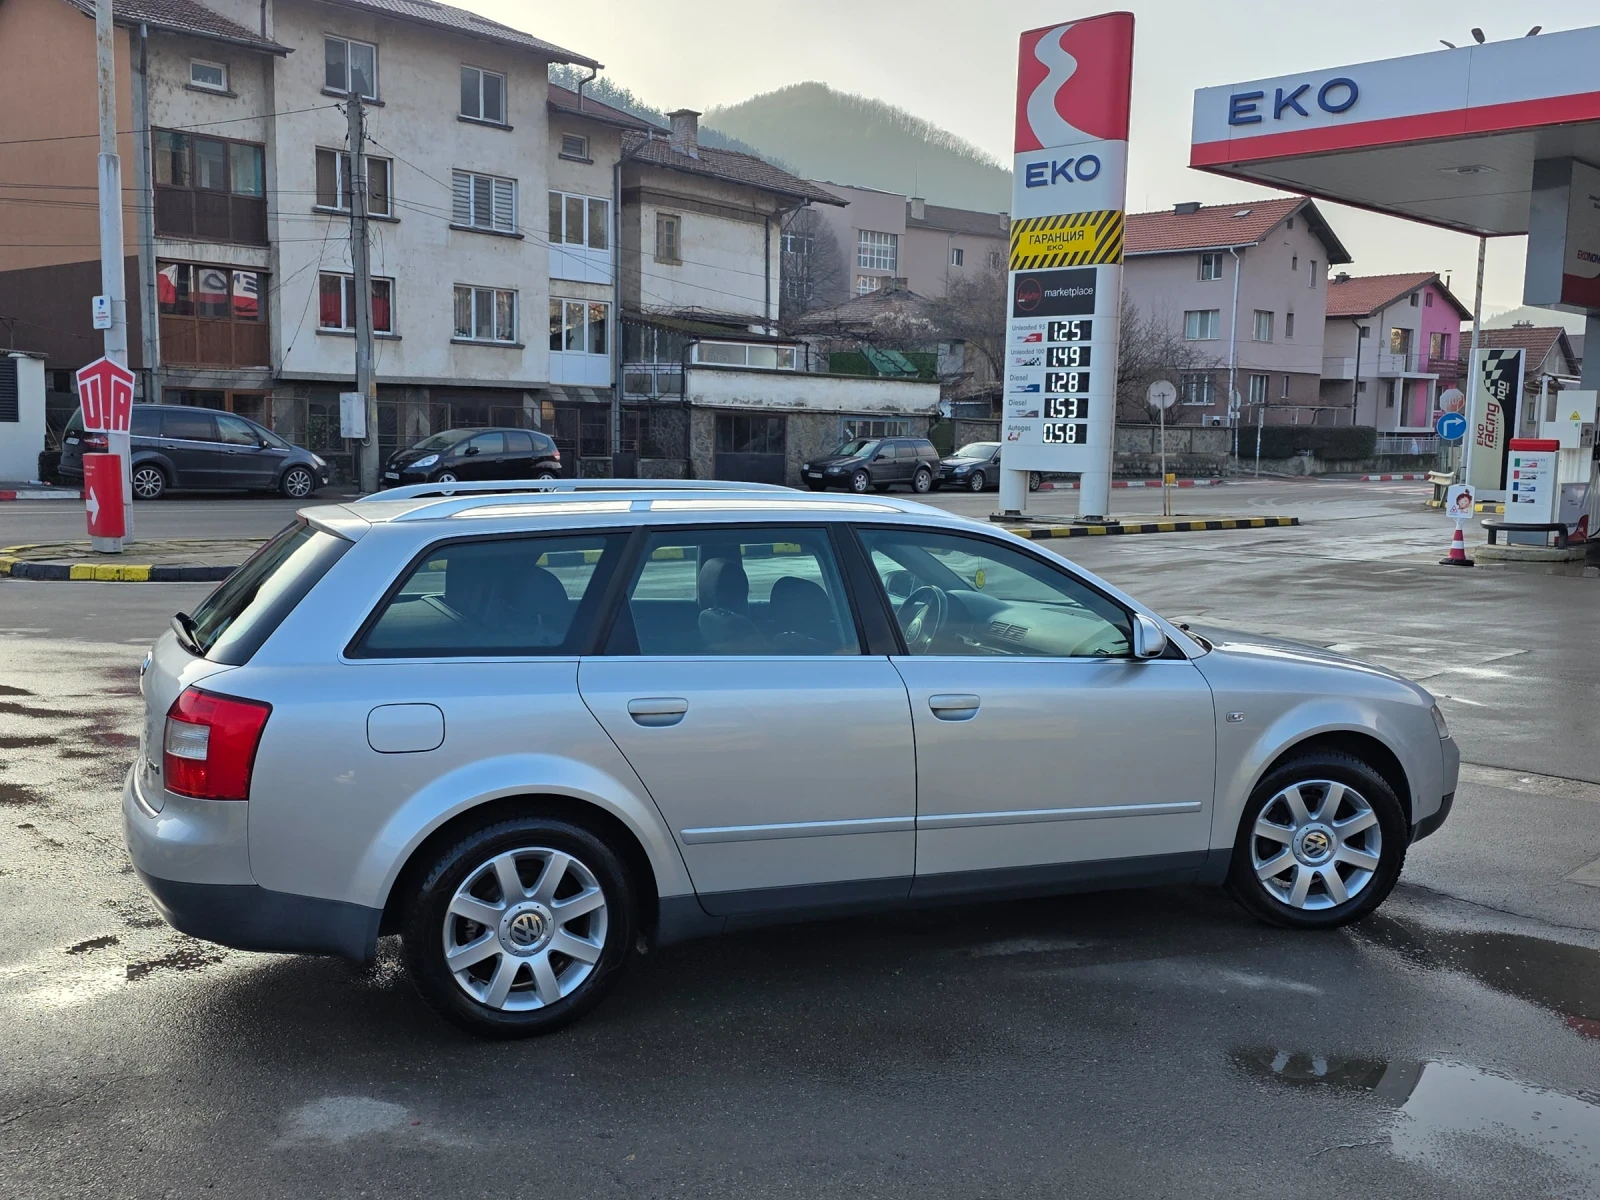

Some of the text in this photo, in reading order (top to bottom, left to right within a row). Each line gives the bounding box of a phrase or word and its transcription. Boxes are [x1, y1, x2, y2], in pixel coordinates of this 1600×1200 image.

[1228, 77, 1359, 125] EKO
[1026, 154, 1101, 188] EKO
[1029, 230, 1085, 245] ГАРАНЦИЯ
[1044, 286, 1094, 299] marketplace
[1054, 320, 1081, 341] 1.25
[1053, 346, 1080, 367] 1.49
[1052, 372, 1079, 392] 1.28
[1497, 380, 1508, 400] 100
[78, 359, 134, 431] UTA
[1051, 398, 1078, 418] 1.53
[1008, 424, 1031, 432] Autogas
[1043, 423, 1077, 443] 0.58
[1477, 423, 1485, 446] EKO
[1484, 402, 1500, 449] racing
